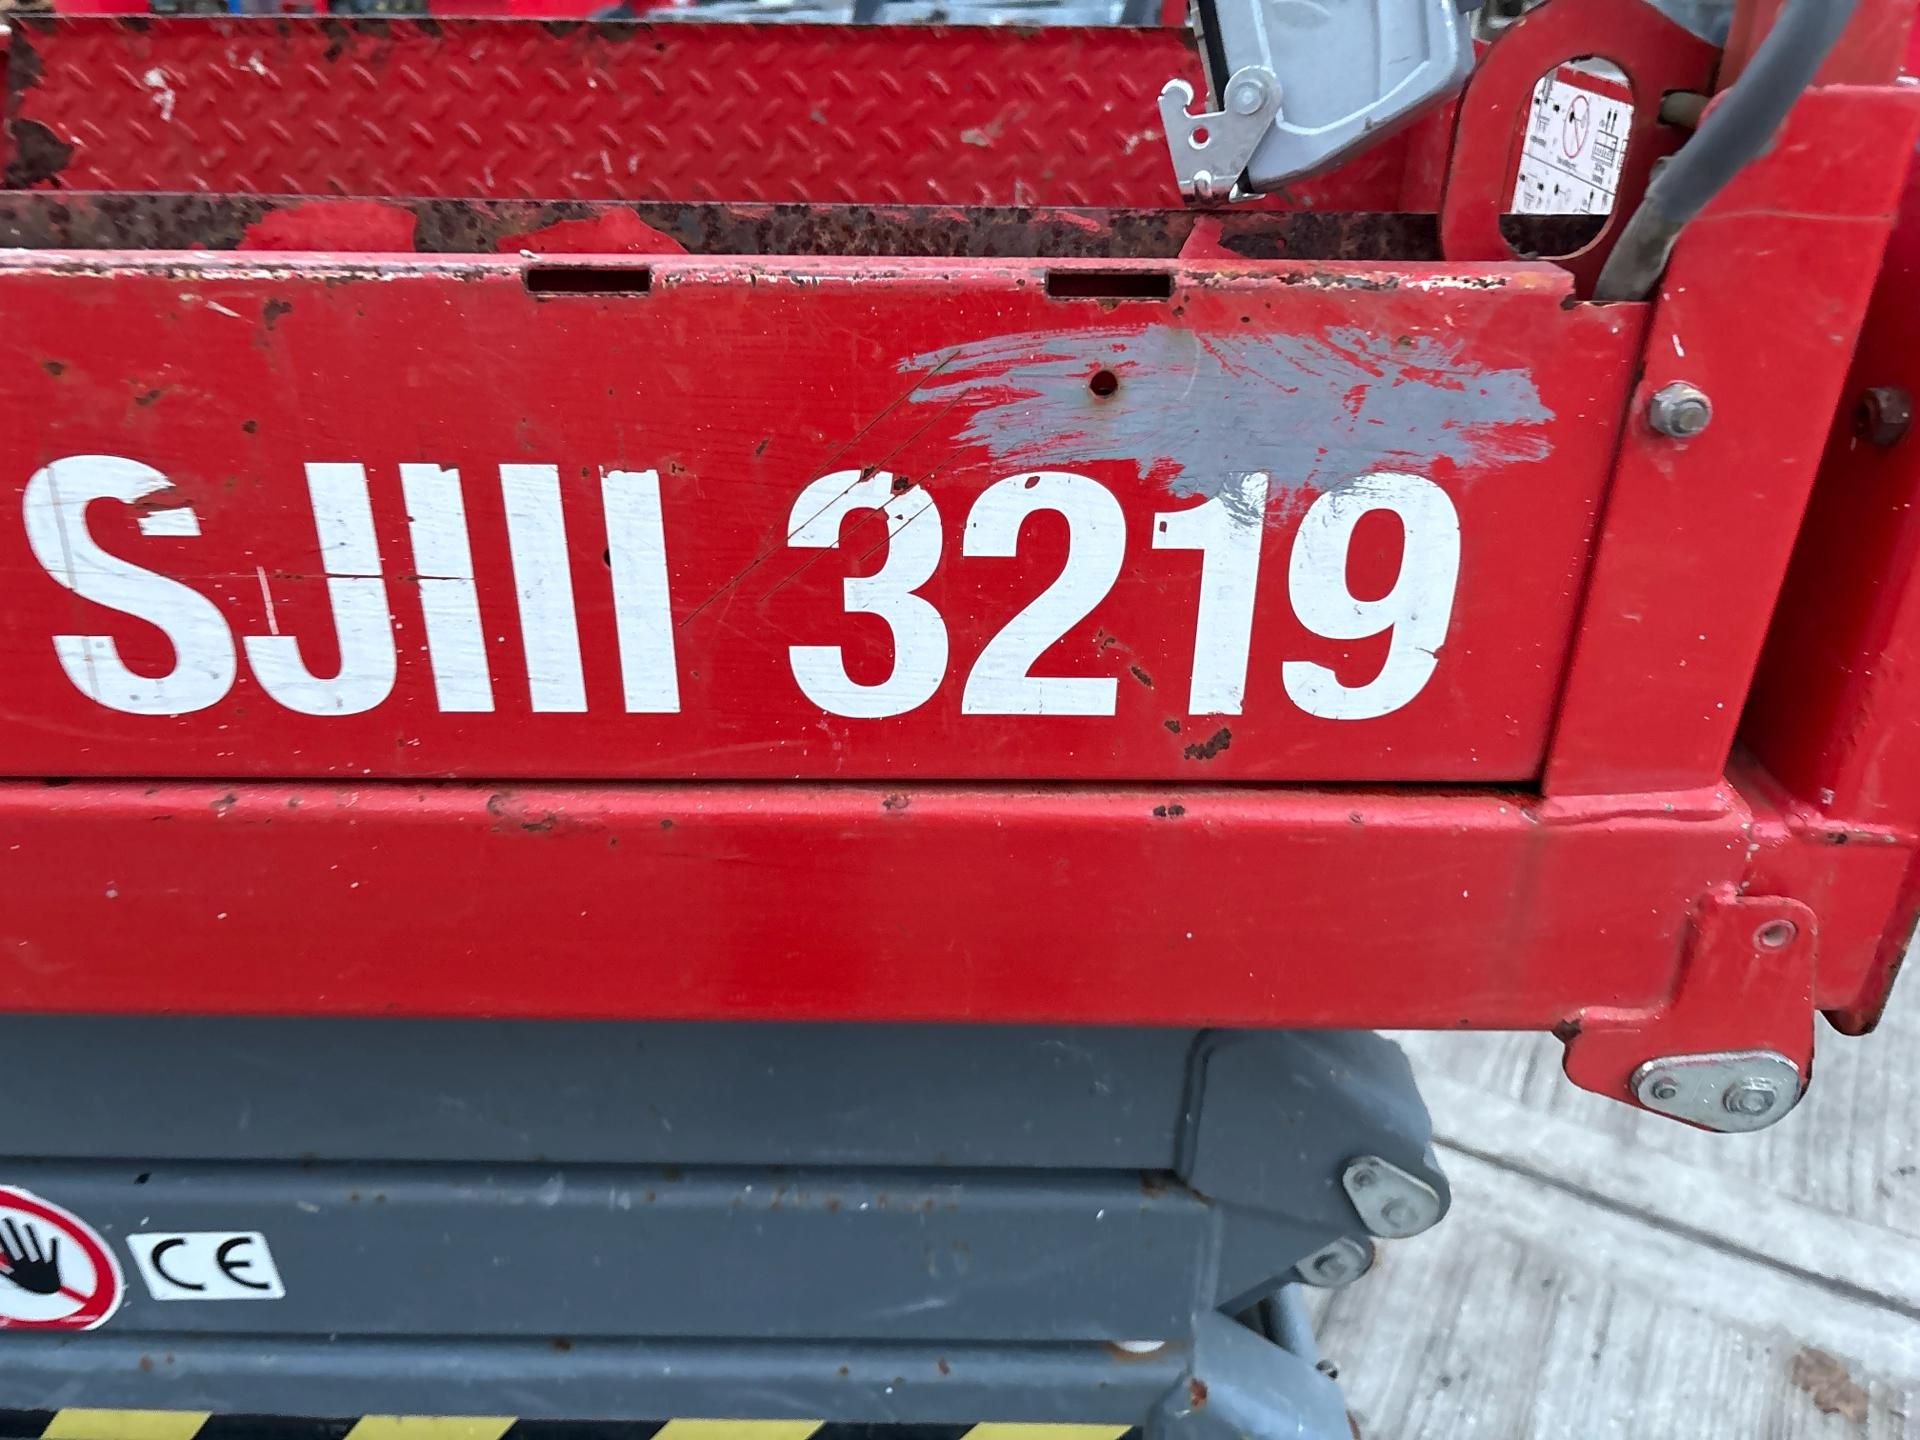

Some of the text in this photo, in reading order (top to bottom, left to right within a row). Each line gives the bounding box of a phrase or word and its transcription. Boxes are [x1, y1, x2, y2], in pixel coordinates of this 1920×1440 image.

[23, 455, 1462, 720] SJIII 3219
[151, 1237, 270, 1291] CE
